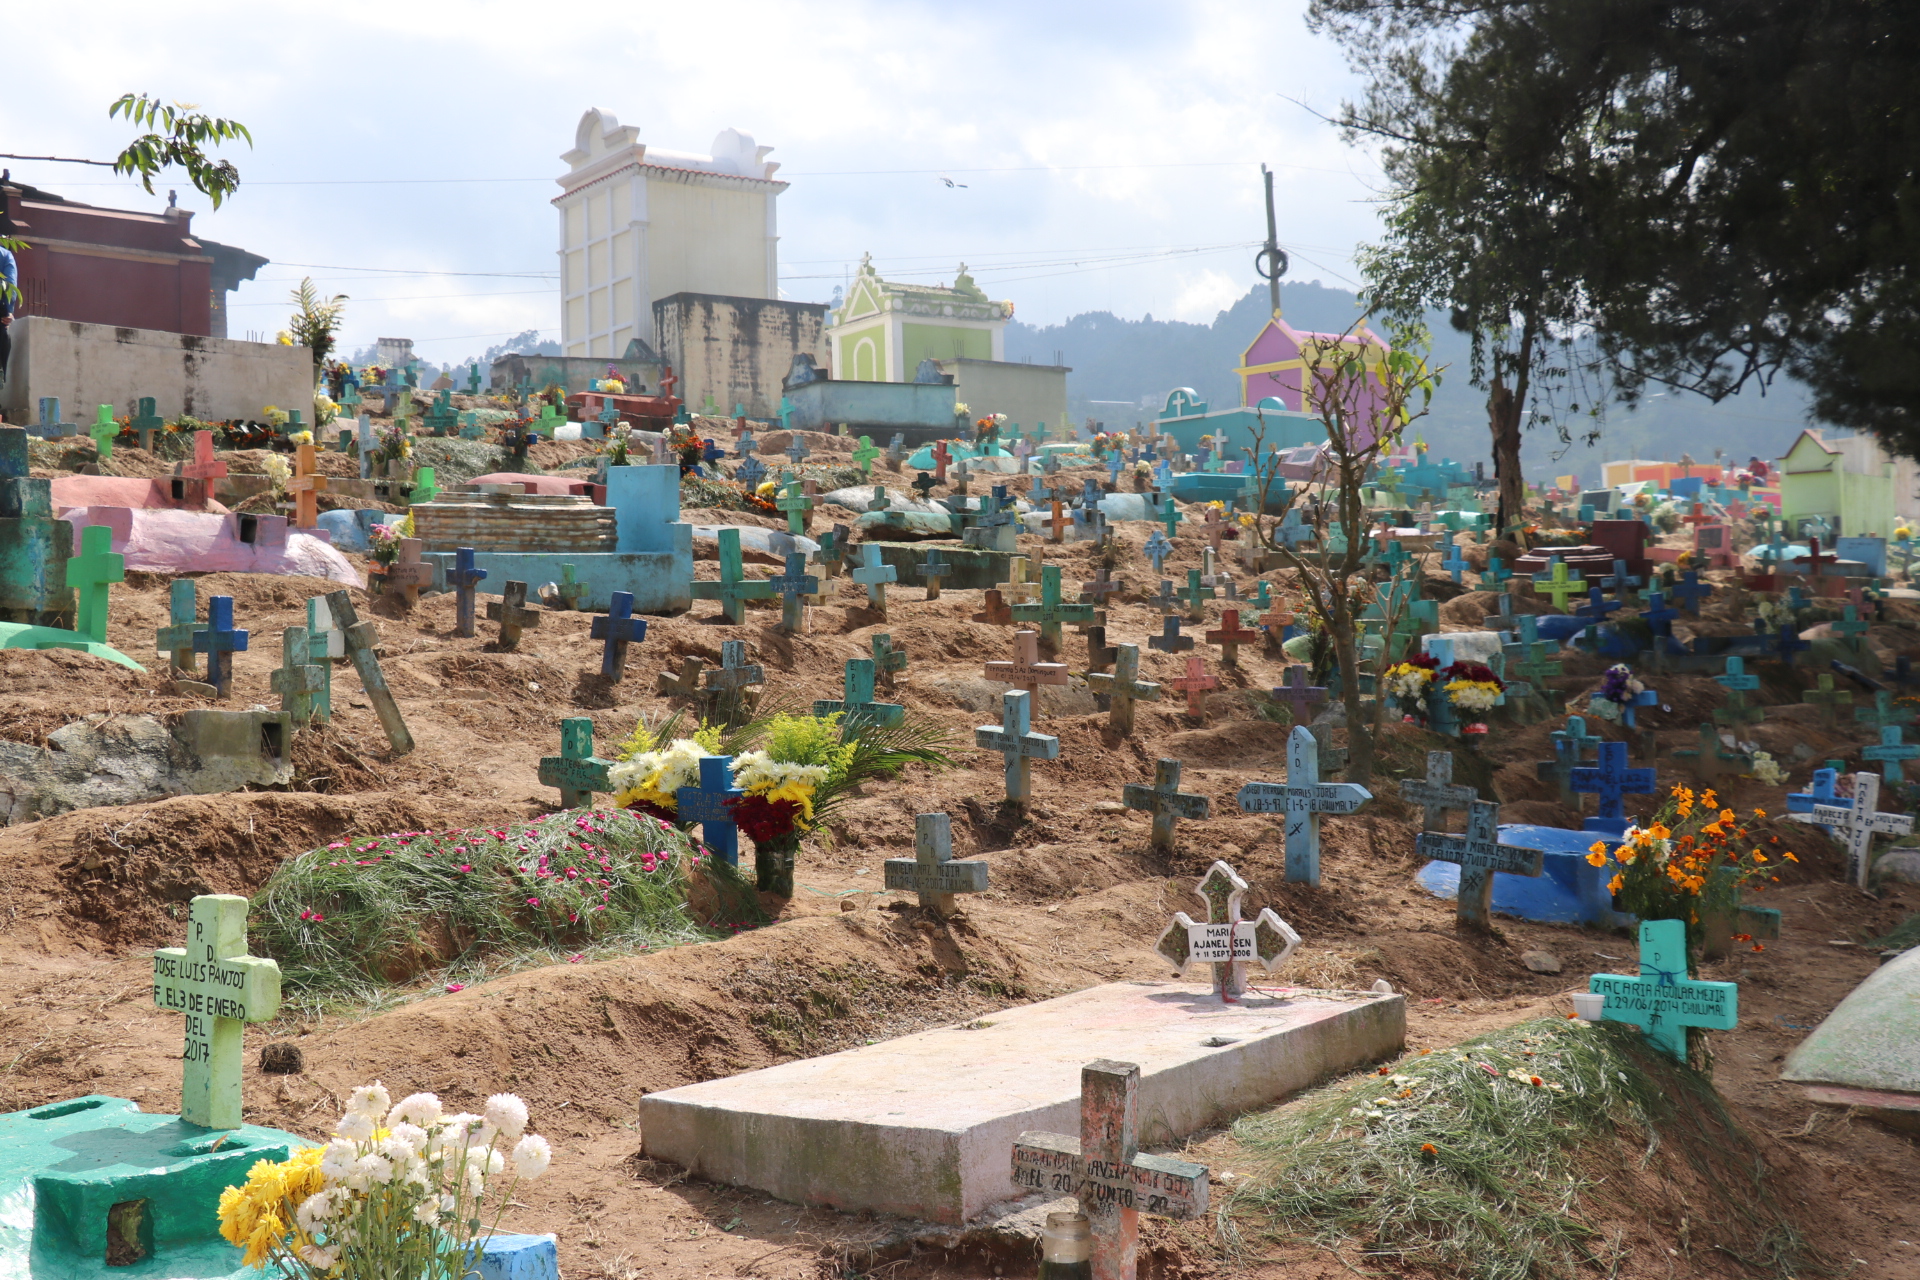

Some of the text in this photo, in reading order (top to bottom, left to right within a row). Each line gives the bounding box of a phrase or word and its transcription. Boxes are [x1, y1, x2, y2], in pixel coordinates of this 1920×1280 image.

[1194, 938, 1251, 950] AJANEL SEN
[1233, 949, 1251, 958] 2006
[153, 955, 246, 990] JOSE LUIS PANJOJ
[1593, 980, 1726, 1004] ZACARIA AGUILAR MEJIA
[189, 993, 204, 1012] DE
[206, 995, 246, 1020] ENERO
[1615, 996, 1680, 1014] 29/06/2014
[1681, 1002, 1727, 1018] CHULUMAL
[185, 1015, 206, 1037] DEL
[183, 1037, 210, 1064] 2017
